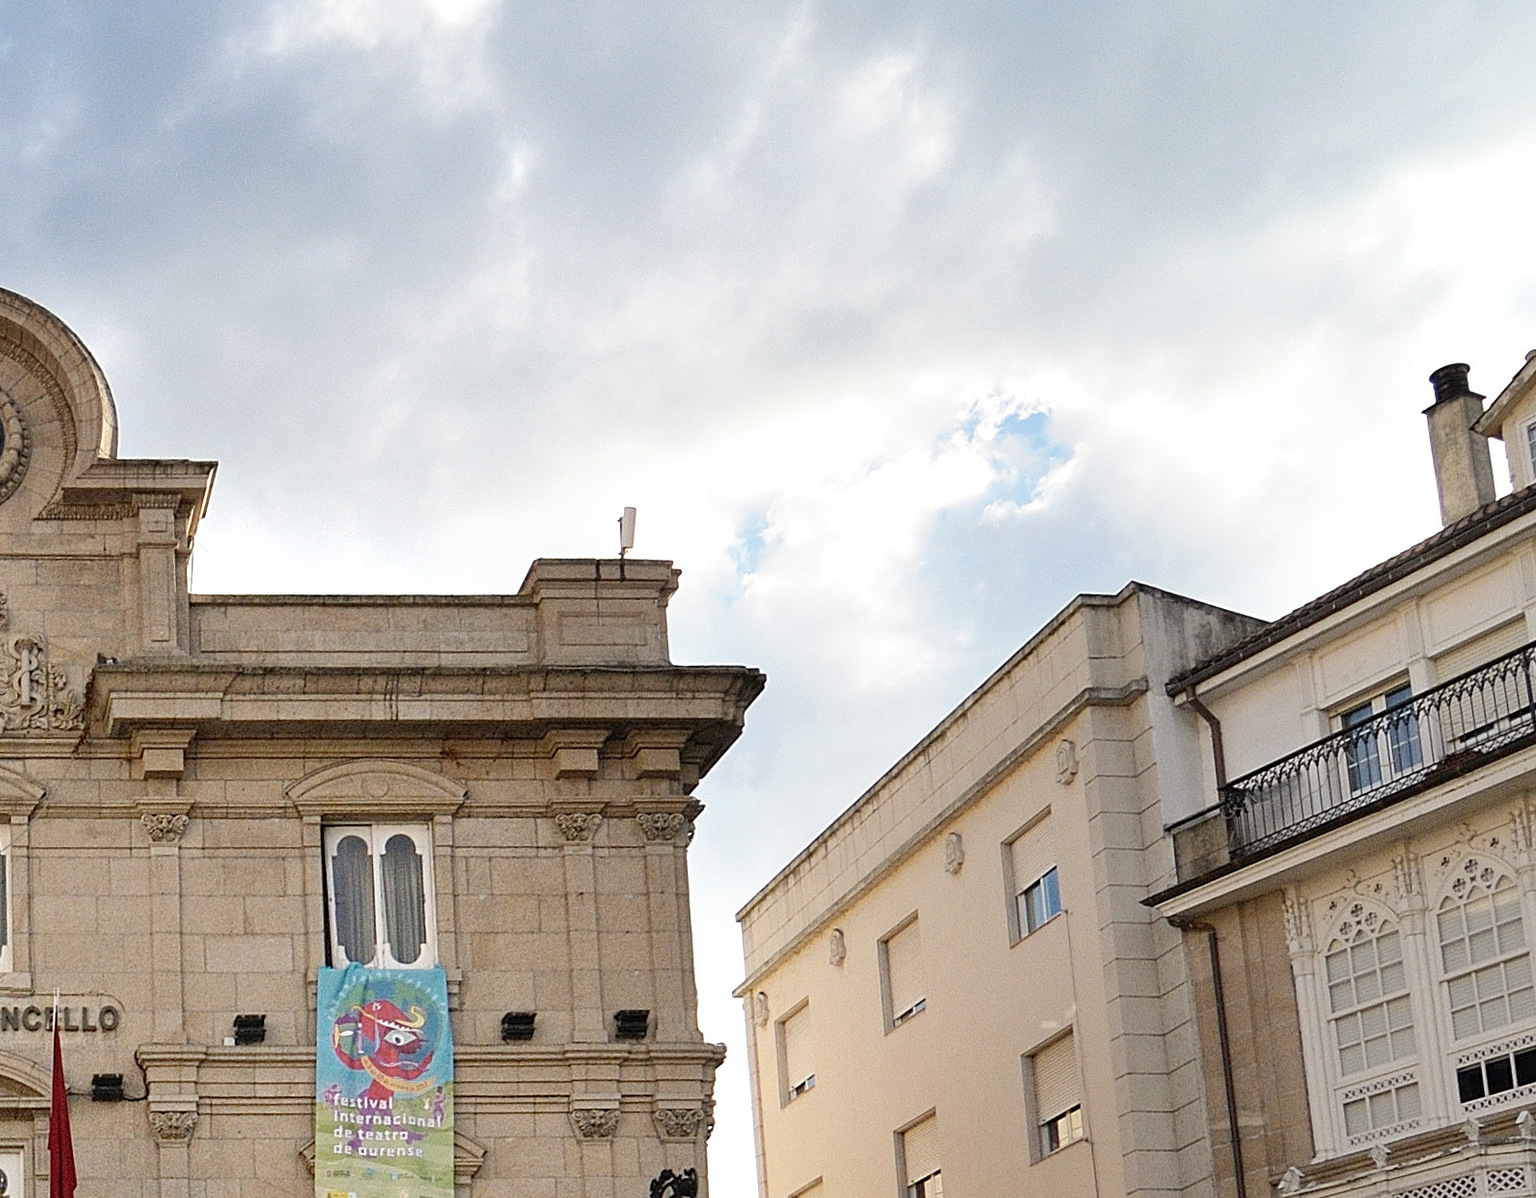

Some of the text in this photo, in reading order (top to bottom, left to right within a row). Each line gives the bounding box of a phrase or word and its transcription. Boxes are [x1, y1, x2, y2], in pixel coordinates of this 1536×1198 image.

[333, 1093, 393, 1110] festival
[334, 1110, 441, 1127] internacional
[333, 1125, 409, 1141] de teatro
[333, 1141, 424, 1158] de ourense
